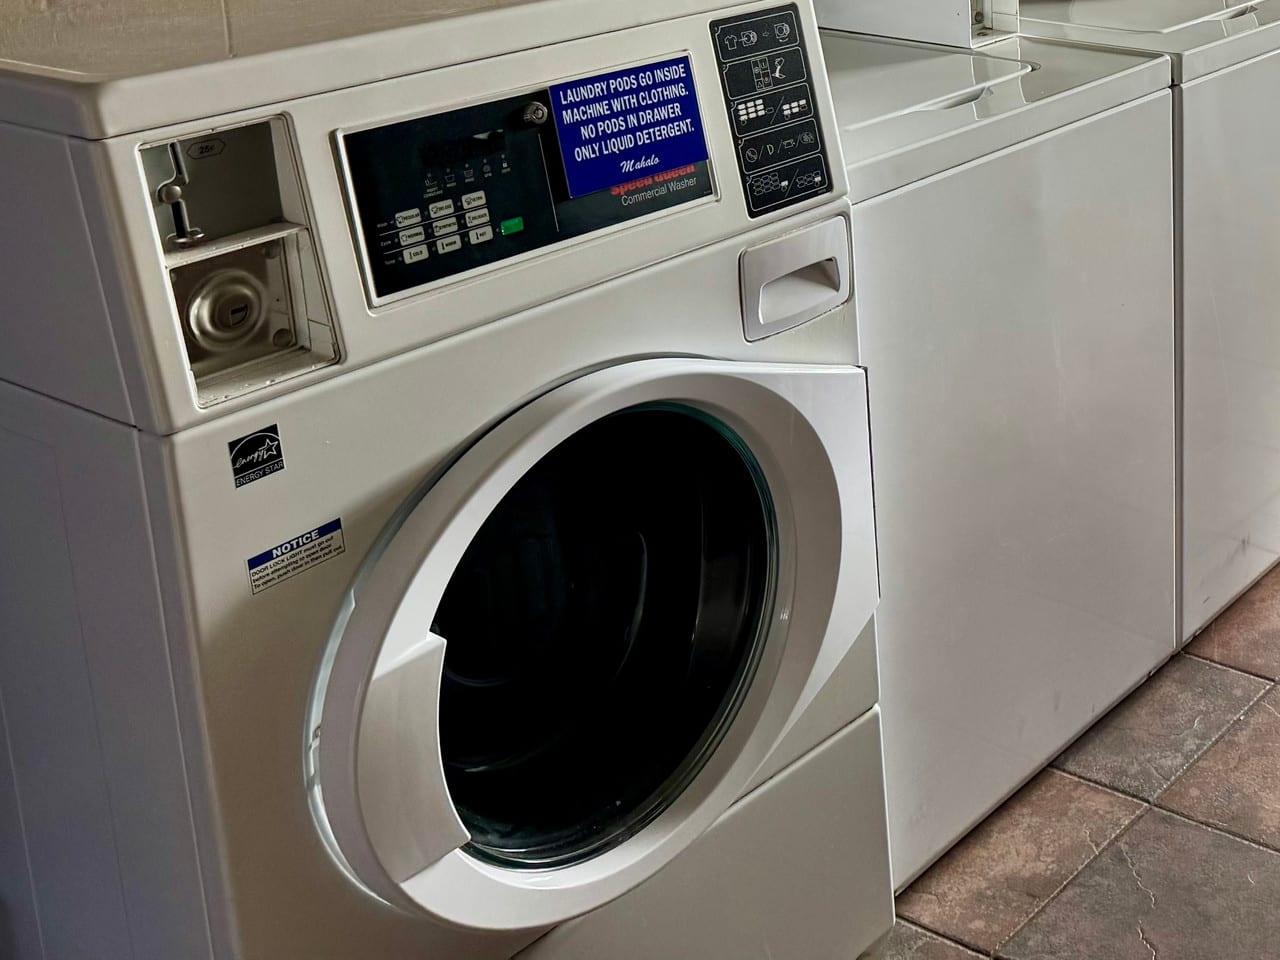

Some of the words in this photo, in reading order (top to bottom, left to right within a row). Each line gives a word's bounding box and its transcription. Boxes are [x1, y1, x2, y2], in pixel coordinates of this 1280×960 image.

[560, 81, 608, 105] LAUNDRY
[609, 75, 637, 94] PODS
[639, 71, 653, 86] GO
[654, 64, 686, 83] INSIDE
[562, 100, 610, 125] MACHINE
[610, 94, 638, 113] WITH
[639, 82, 688, 106] CLOTHING.
[580, 124, 596, 140] NO
[597, 116, 626, 136] PODS
[627, 113, 638, 129] IN
[639, 103, 682, 126] DRAWER
[574, 142, 600, 162] ONLY
[602, 135, 635, 156] LIQUID
[637, 119, 695, 146] DETERGENT.
[620, 154, 660, 173] Mahalo
[621, 185, 667, 206] Commercial
[669, 176, 697, 192] Washer
[236, 470, 263, 487] ENERGY
[265, 461, 284, 475] STAR
[272, 530, 320, 558] NOTICE
[252, 565, 269, 578] DOOR
[270, 559, 285, 569] LOCK
[286, 550, 302, 561] LIGHT
